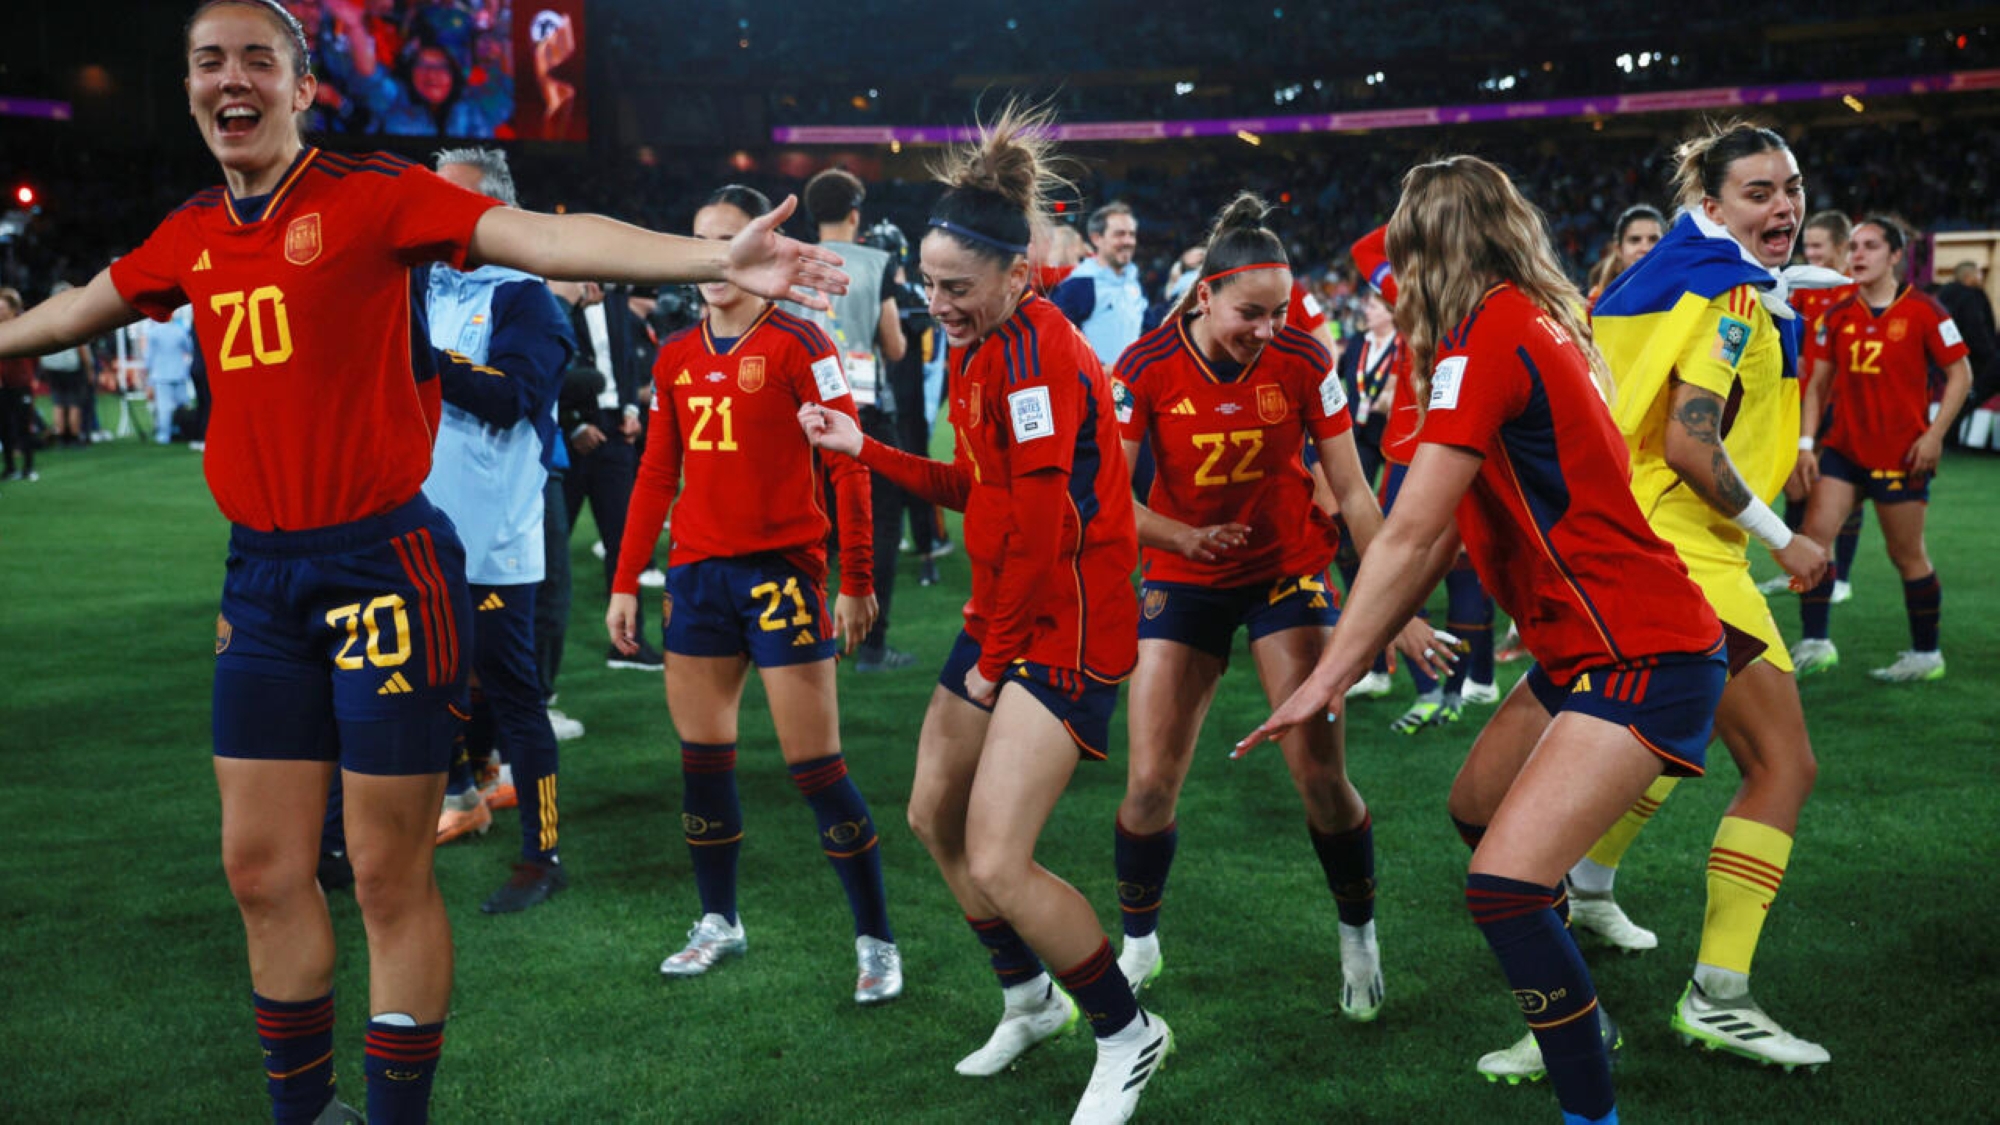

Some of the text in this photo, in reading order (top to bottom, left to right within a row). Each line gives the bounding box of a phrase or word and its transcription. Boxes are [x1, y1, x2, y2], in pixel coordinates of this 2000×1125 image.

[209, 285, 294, 372] 20
[1850, 340, 1883, 374] 12
[688, 396, 738, 451] 21
[1192, 429, 1264, 487] 22
[325, 592, 412, 671] 20
[751, 576, 812, 632] 21
